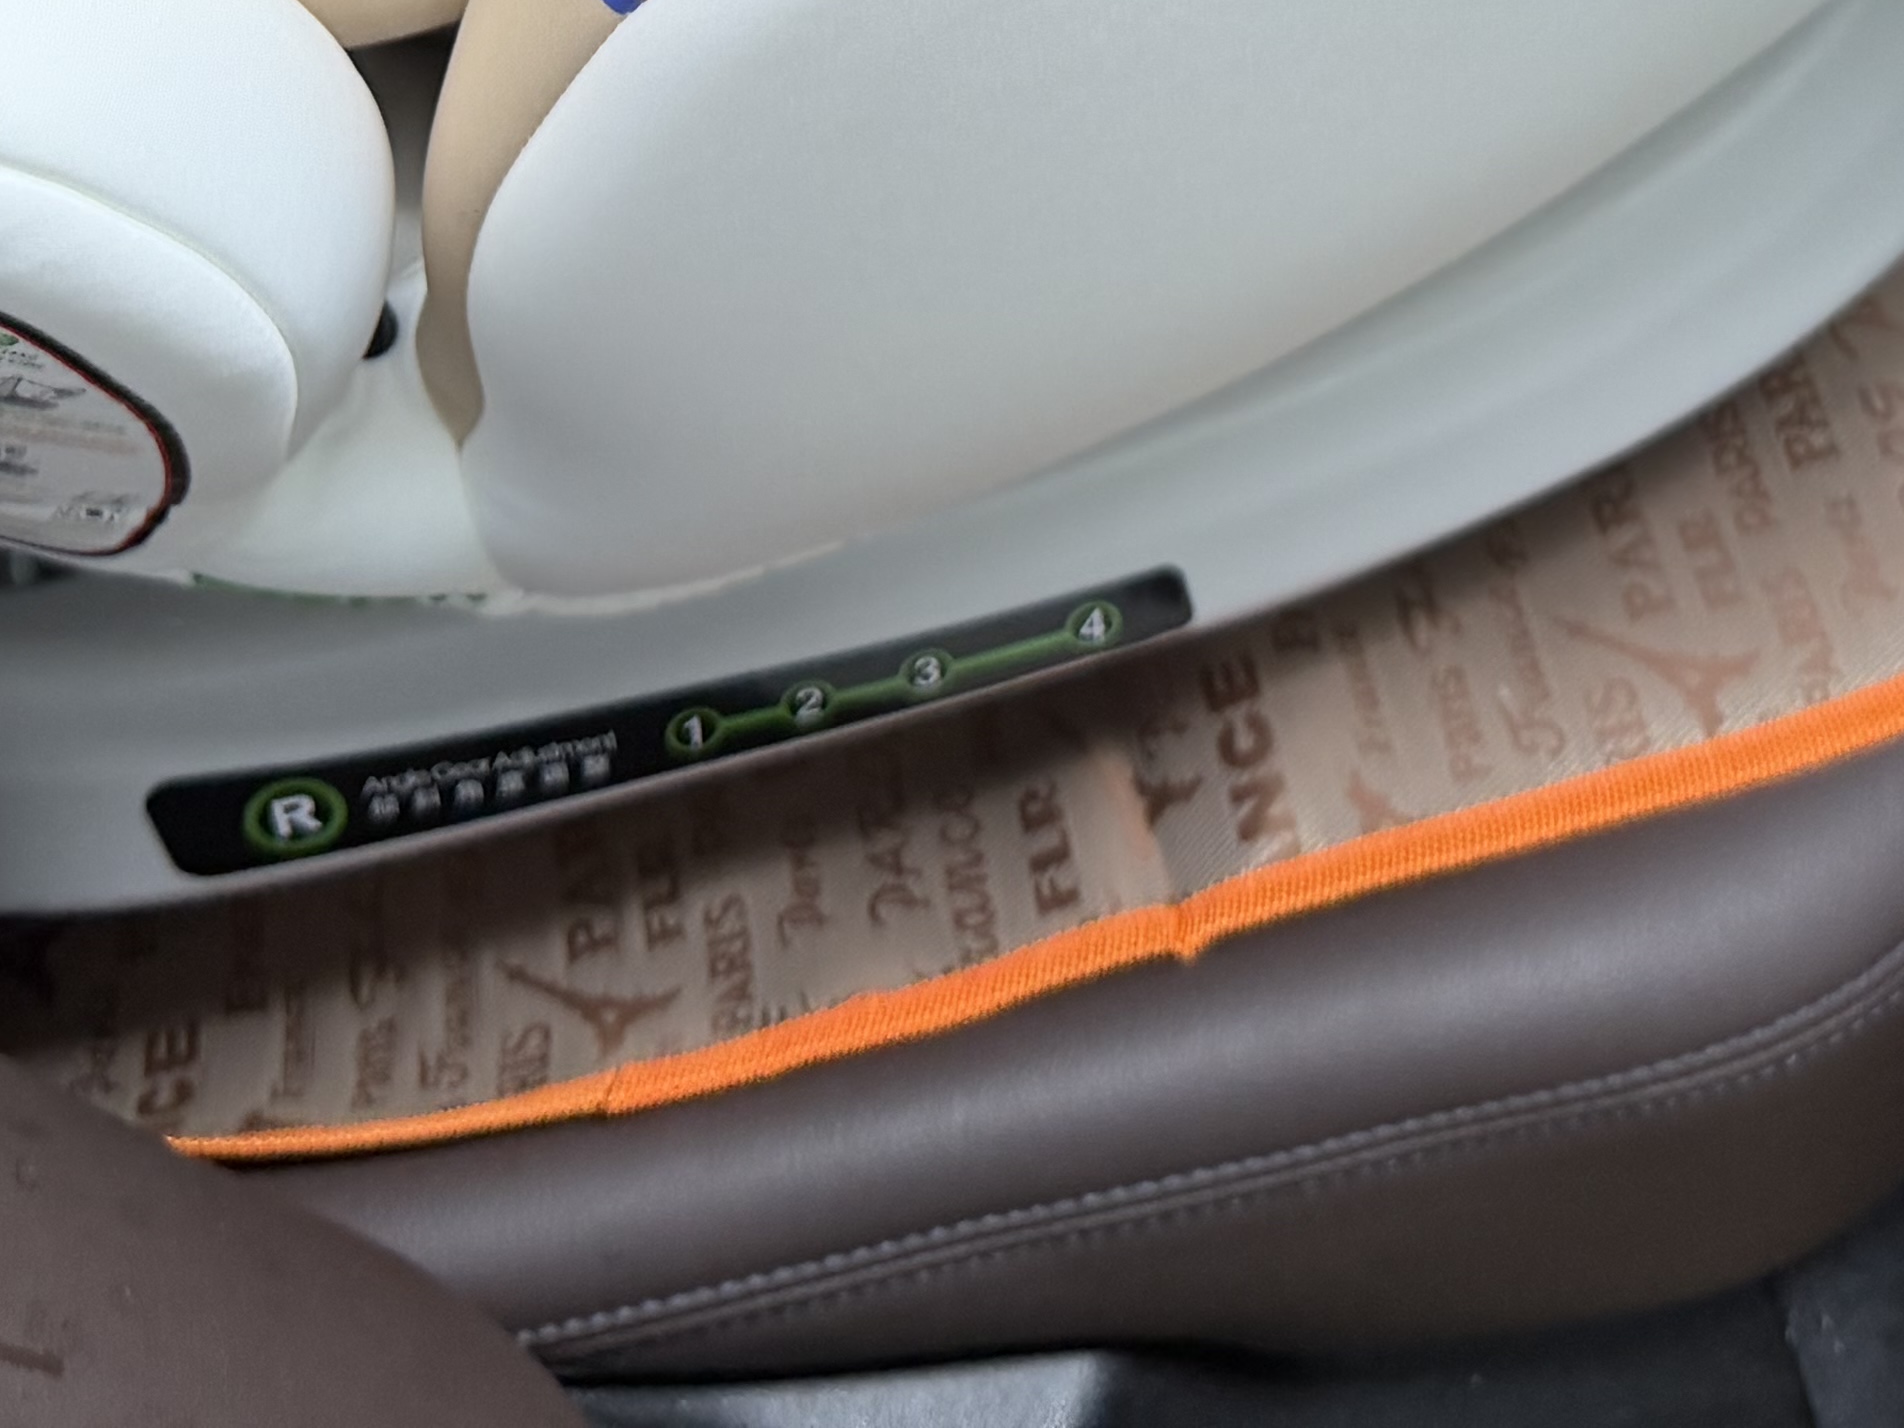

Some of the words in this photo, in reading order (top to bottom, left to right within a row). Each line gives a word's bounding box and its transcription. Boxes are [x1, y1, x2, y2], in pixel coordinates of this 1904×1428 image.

[681, 714, 704, 750] 1
[795, 686, 824, 721] 2
[912, 655, 942, 689] 3
[1078, 606, 1107, 643] 4
[269, 792, 324, 840] R
